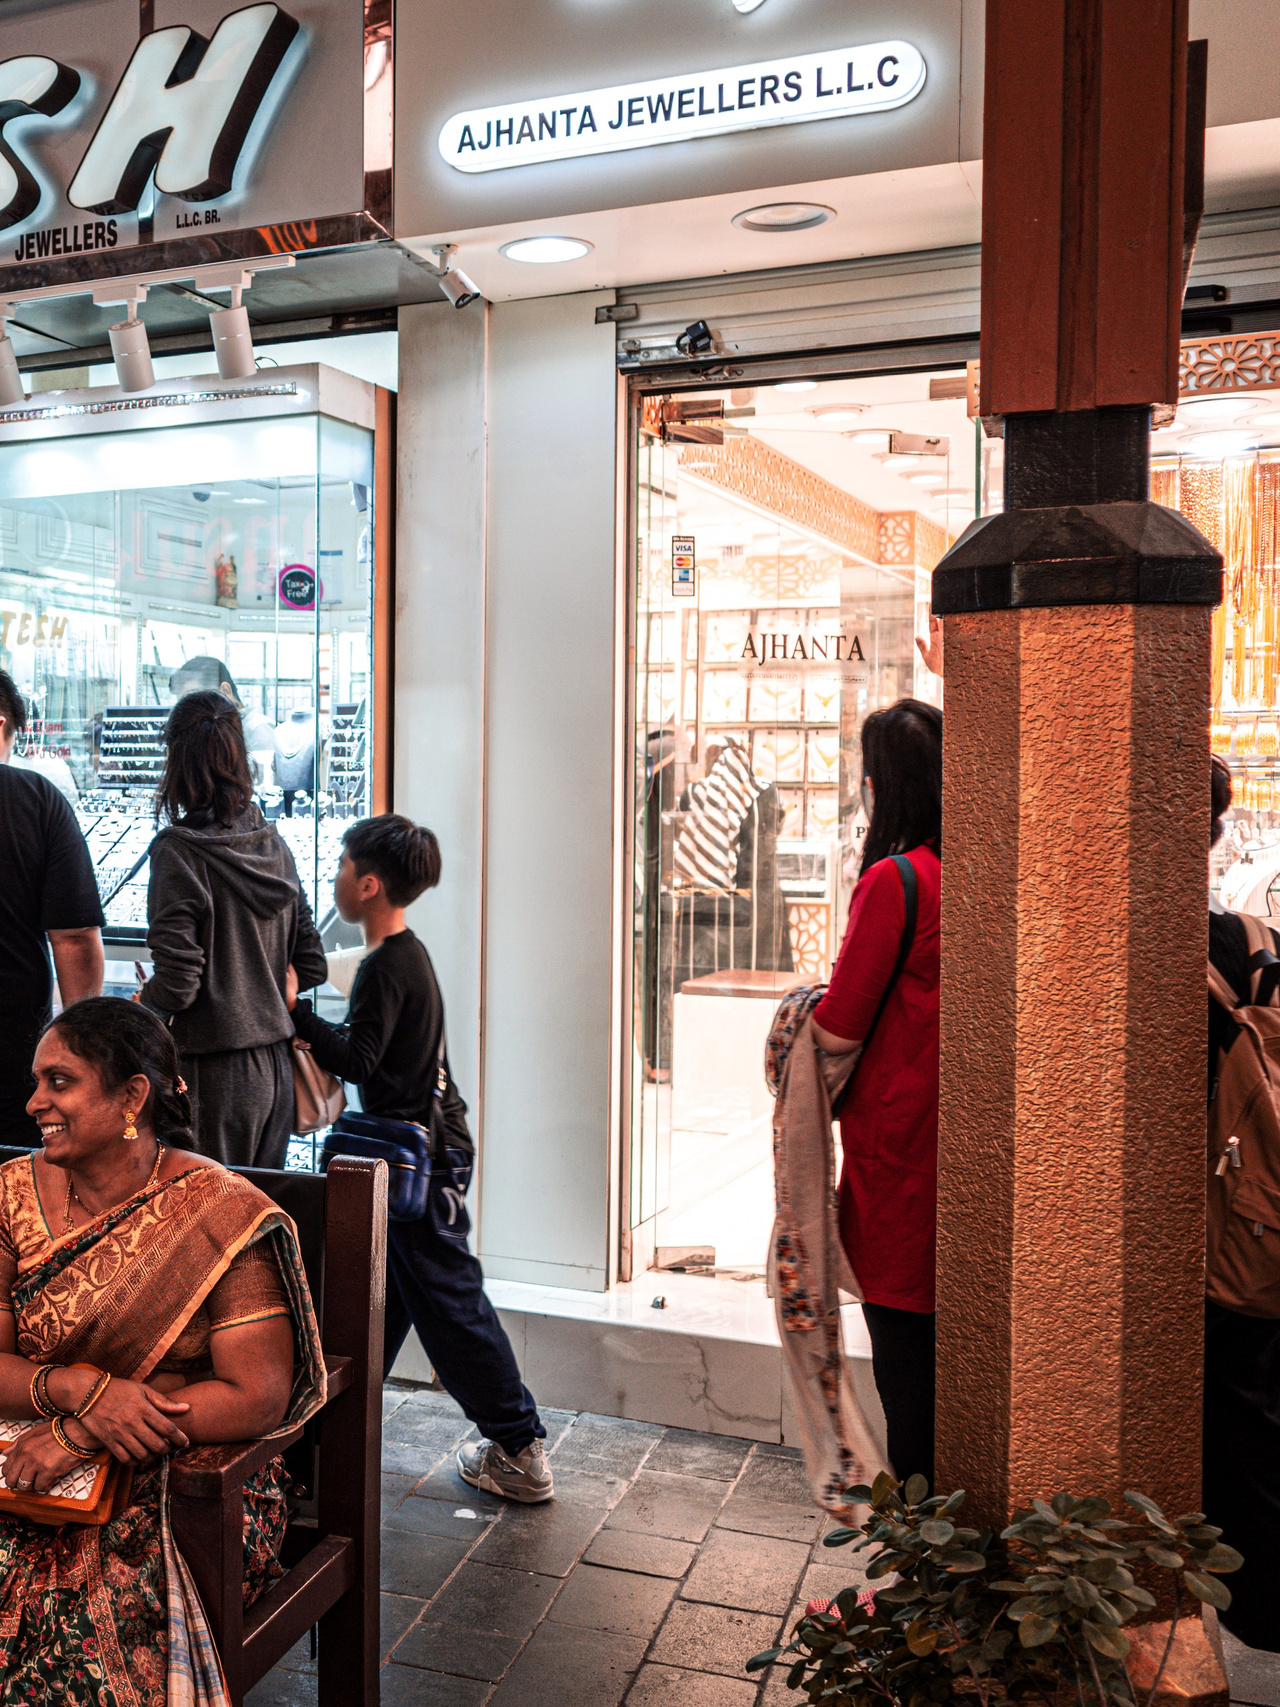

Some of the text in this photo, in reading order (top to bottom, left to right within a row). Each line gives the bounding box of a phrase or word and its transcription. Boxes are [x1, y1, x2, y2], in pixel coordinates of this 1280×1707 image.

[456, 55, 900, 154] AJHANTA JEWELLERS L.L.C
[14, 208, 221, 262] JEWELLERS L.L.C. BR.
[675, 544, 692, 552] VISA
[285, 579, 300, 588] Tax
[286, 589, 307, 599] Free
[740, 632, 866, 667] AJHANTA
[48, 743, 72, 760] Gold
